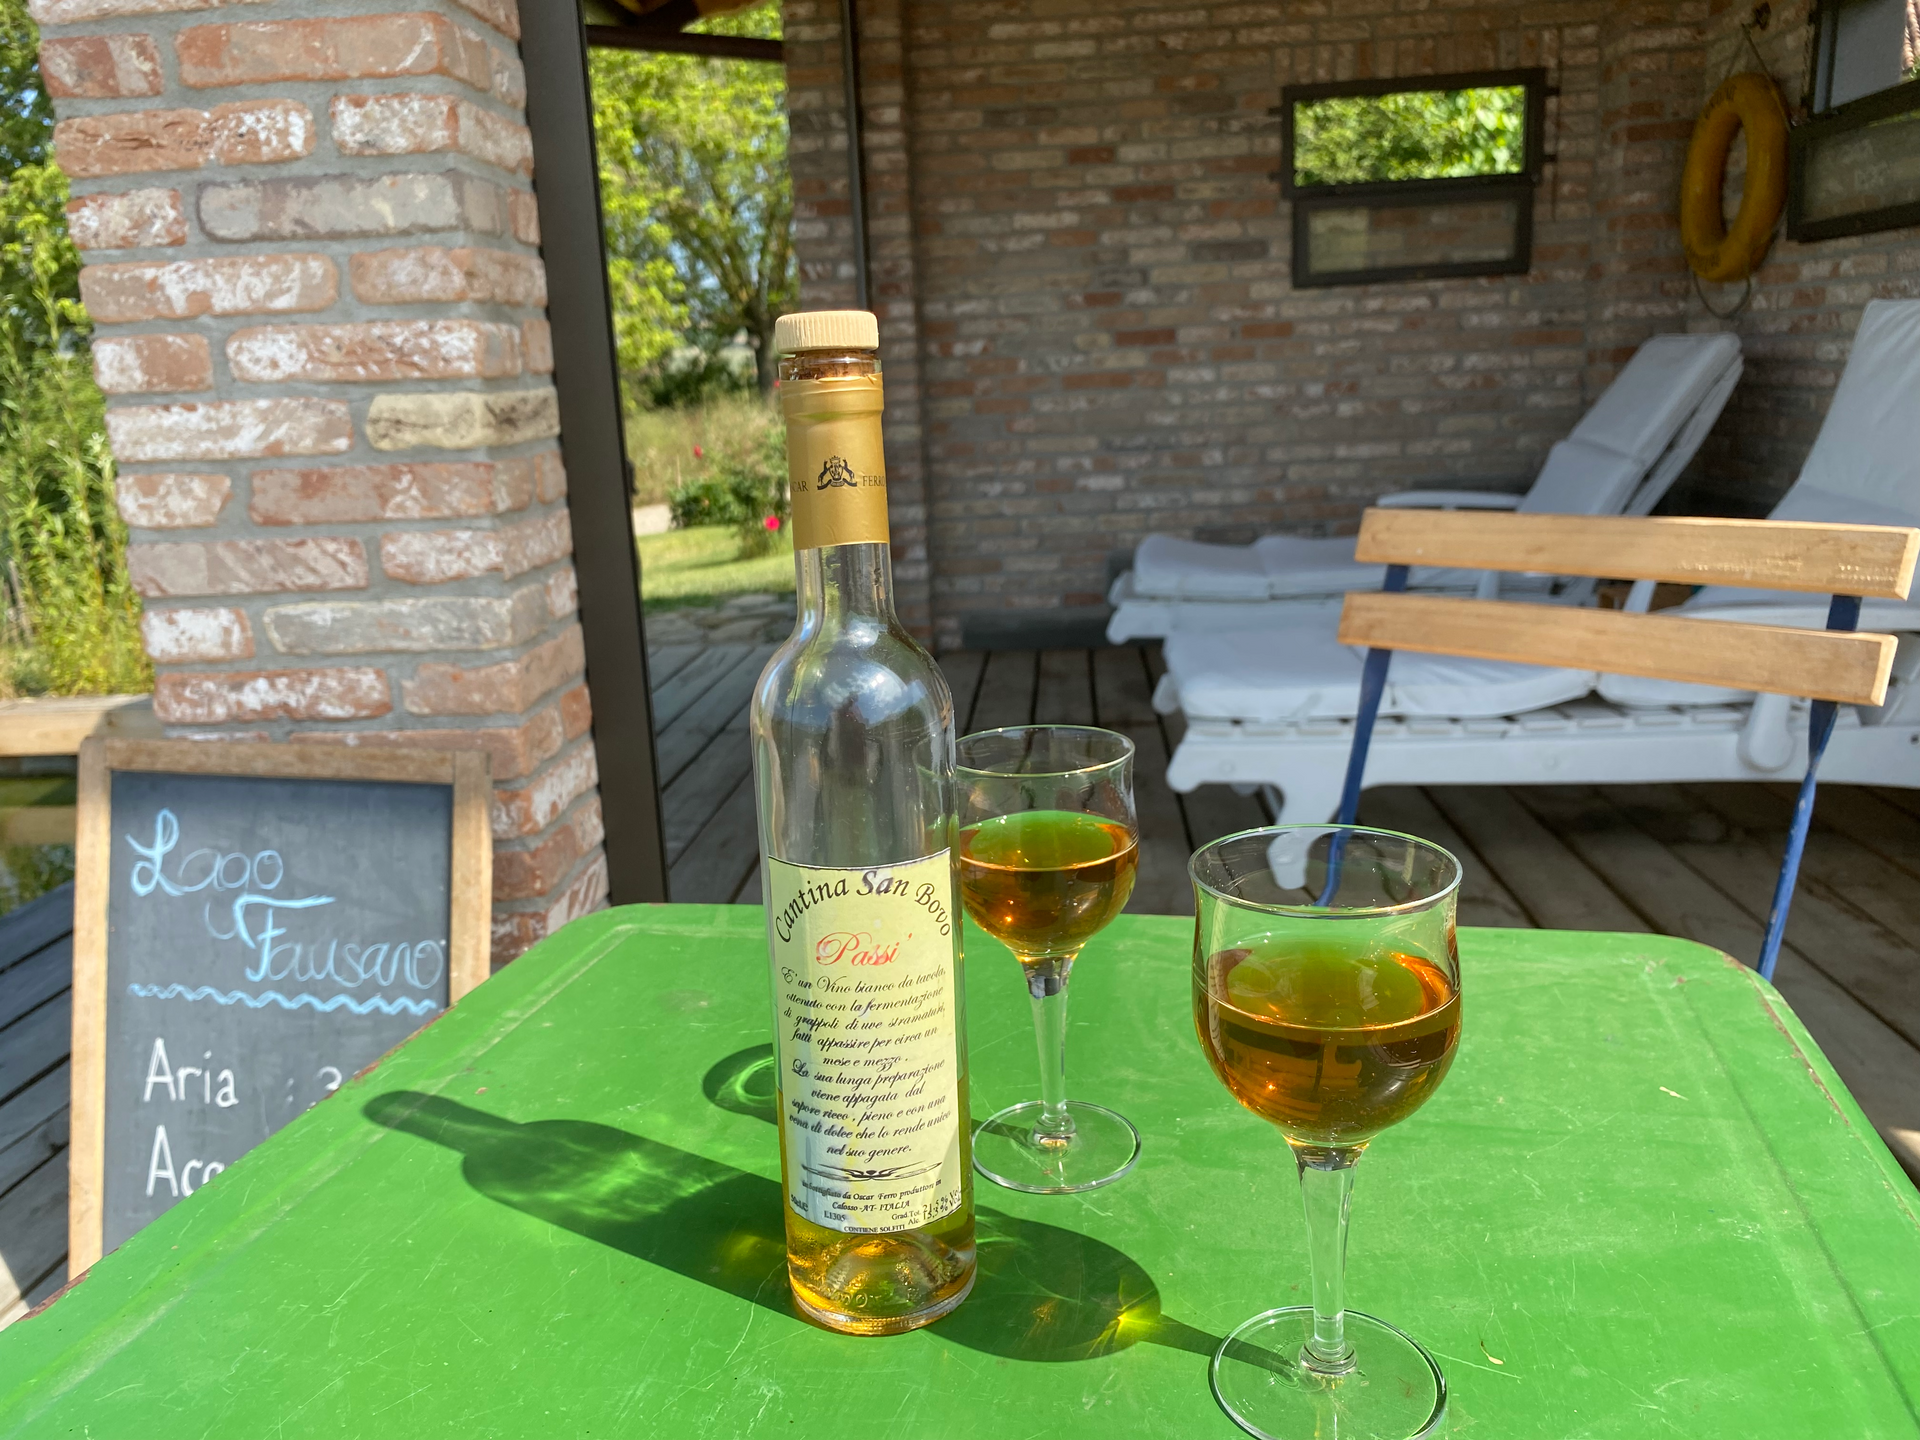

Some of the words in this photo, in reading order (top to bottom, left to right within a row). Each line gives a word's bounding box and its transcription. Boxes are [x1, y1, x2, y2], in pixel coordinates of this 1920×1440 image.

[125, 807, 284, 939] Lago
[776, 878, 849, 943] Cantina
[856, 870, 909, 897] San
[914, 882, 951, 936] Bovo
[797, 979, 813, 989] un
[817, 975, 852, 994] Vino
[854, 980, 895, 994] bianco
[897, 974, 915, 989] da
[786, 993, 823, 1009] ottenuto
[825, 1002, 847, 1012] con
[850, 999, 865, 1012] la
[858, 986, 944, 1018] fermentazione
[783, 1006, 793, 1018] di
[793, 1015, 840, 1032] grappoli
[845, 1017, 860, 1030] di
[860, 1021, 883, 1030] uve
[790, 1027, 812, 1043] fatti
[817, 1037, 871, 1053] appassire
[867, 1037, 892, 1054] per
[894, 1033, 923, 1045] circa
[924, 1026, 939, 1038] un
[143, 1037, 239, 1108] Aria
[791, 1058, 810, 1078] La
[814, 1072, 835, 1084] sua
[835, 1072, 872, 1092] lunga
[870, 1059, 946, 1091] preparazione
[822, 1057, 851, 1067] mese
[853, 1059, 861, 1067] e
[863, 1055, 902, 1073] mezzo
[811, 1089, 841, 1102] viene
[842, 1091, 899, 1110] appagata
[905, 1081, 926, 1098] dal
[789, 1114, 810, 1130] vena
[810, 1120, 823, 1134] di
[823, 1124, 854, 1139] dolce
[855, 1126, 877, 1140] che
[877, 1126, 890, 1139] lo
[892, 1118, 926, 1137] rende
[926, 1110, 951, 1128] unico
[791, 1098, 822, 1116] sapore
[822, 1109, 850, 1120] ricco
[856, 1111, 894, 1127] pieno
[896, 1109, 904, 1118] e
[905, 1104, 926, 1117] con
[927, 1095, 947, 1110] una
[826, 1144, 847, 1156] nel
[845, 1147, 867, 1157] suo
[863, 1144, 912, 1164] genere.
[831, 1201, 858, 1212] Calosso
[879, 1200, 910, 1212] ITALIA
[842, 1191, 852, 1200] da
[853, 1193, 875, 1201] Oscar
[877, 1192, 898, 1201] Ferro
[879, 1224, 905, 1233] SOLFITI
